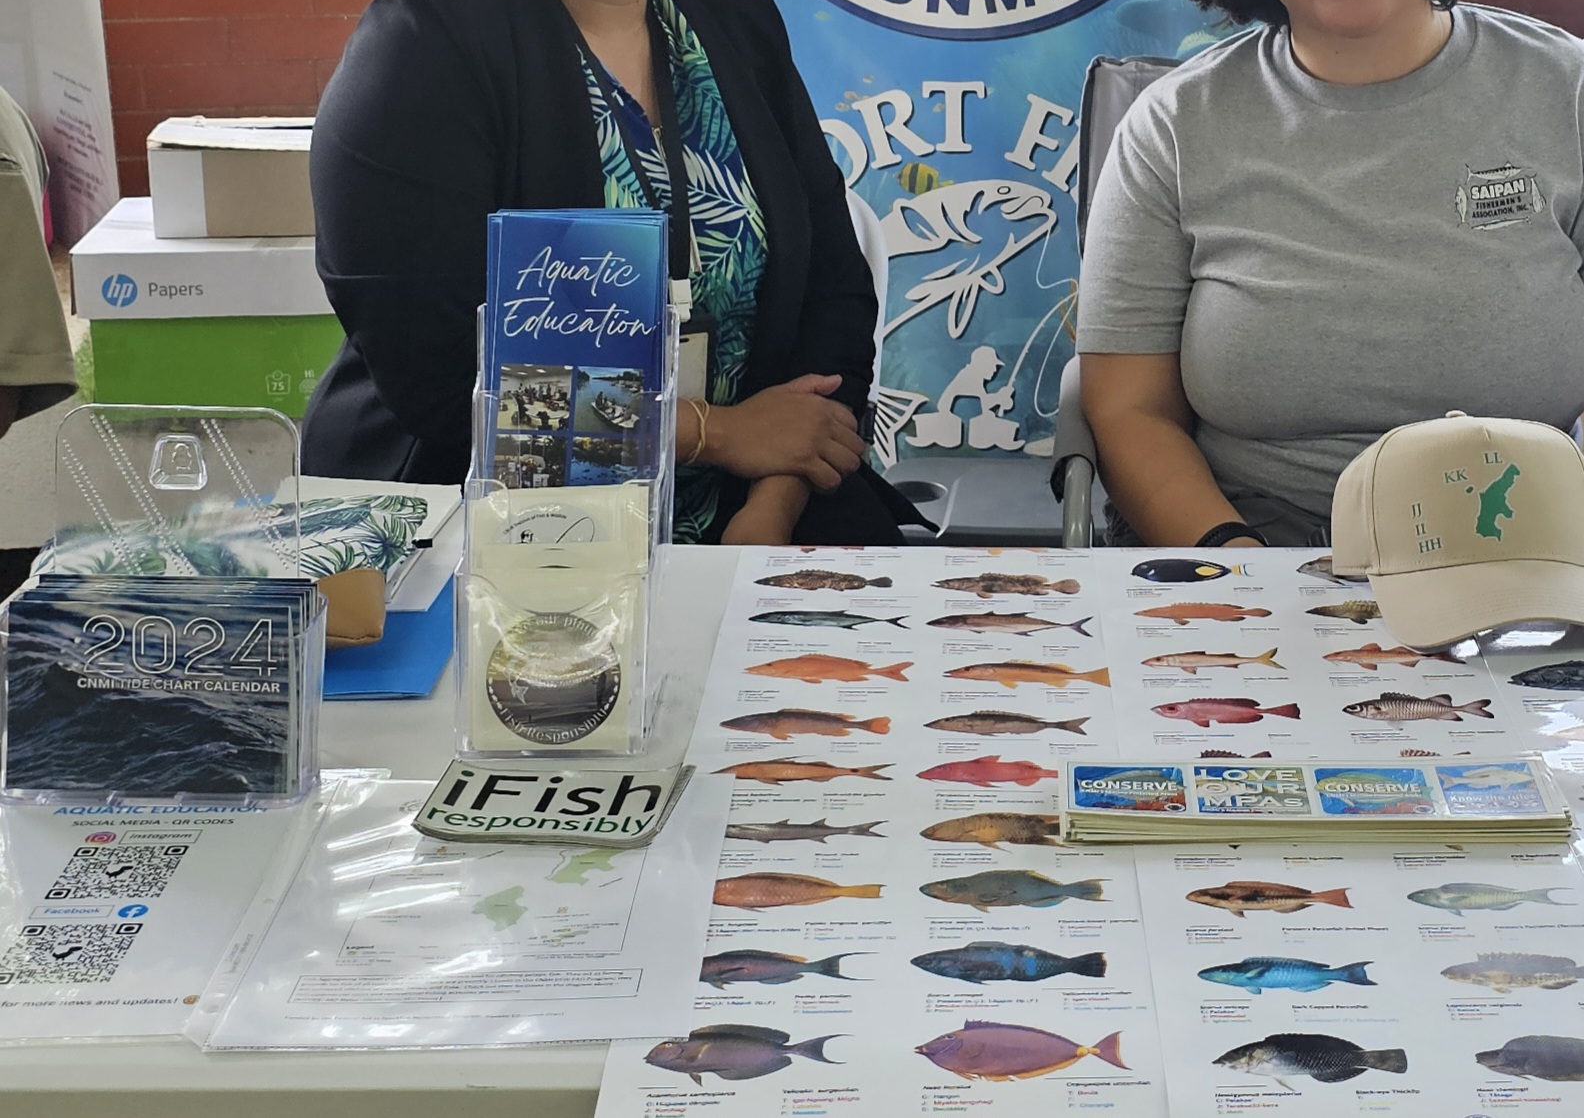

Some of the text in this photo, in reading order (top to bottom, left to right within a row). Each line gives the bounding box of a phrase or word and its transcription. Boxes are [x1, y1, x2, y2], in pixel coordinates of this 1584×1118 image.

[820, 80, 987, 189] ORT
[1471, 178, 1526, 200] SAIPAN
[516, 246, 641, 297] Aquatic
[107, 274, 204, 307] hp Papers
[503, 297, 658, 348] Education
[271, 381, 285, 392] 75
[1484, 452, 1503, 465] LL
[1443, 469, 1469, 483] KK
[1411, 502, 1423, 519] JJ
[1415, 523, 1426, 535] II
[1418, 537, 1442, 554] HH
[82, 614, 278, 677] 2024
[77, 677, 280, 693] CNMI TIDE CHART CALENDAR
[1200, 769, 1299, 781] LOVE
[1081, 779, 1178, 791] CONSERVE
[1203, 783, 1301, 794] OUR
[1324, 783, 1421, 793] CONSERVE
[443, 770, 662, 816] iFish
[53, 806, 145, 816] AQUATIC
[72, 819, 116, 827] SOCIAL
[427, 806, 655, 836] responsibly
[44, 907, 101, 915] Facebook
[1, 999, 19, 1008] for
[23, 999, 57, 1008] more
[97, 998, 119, 1007] and
[122, 997, 178, 1006] updates!
